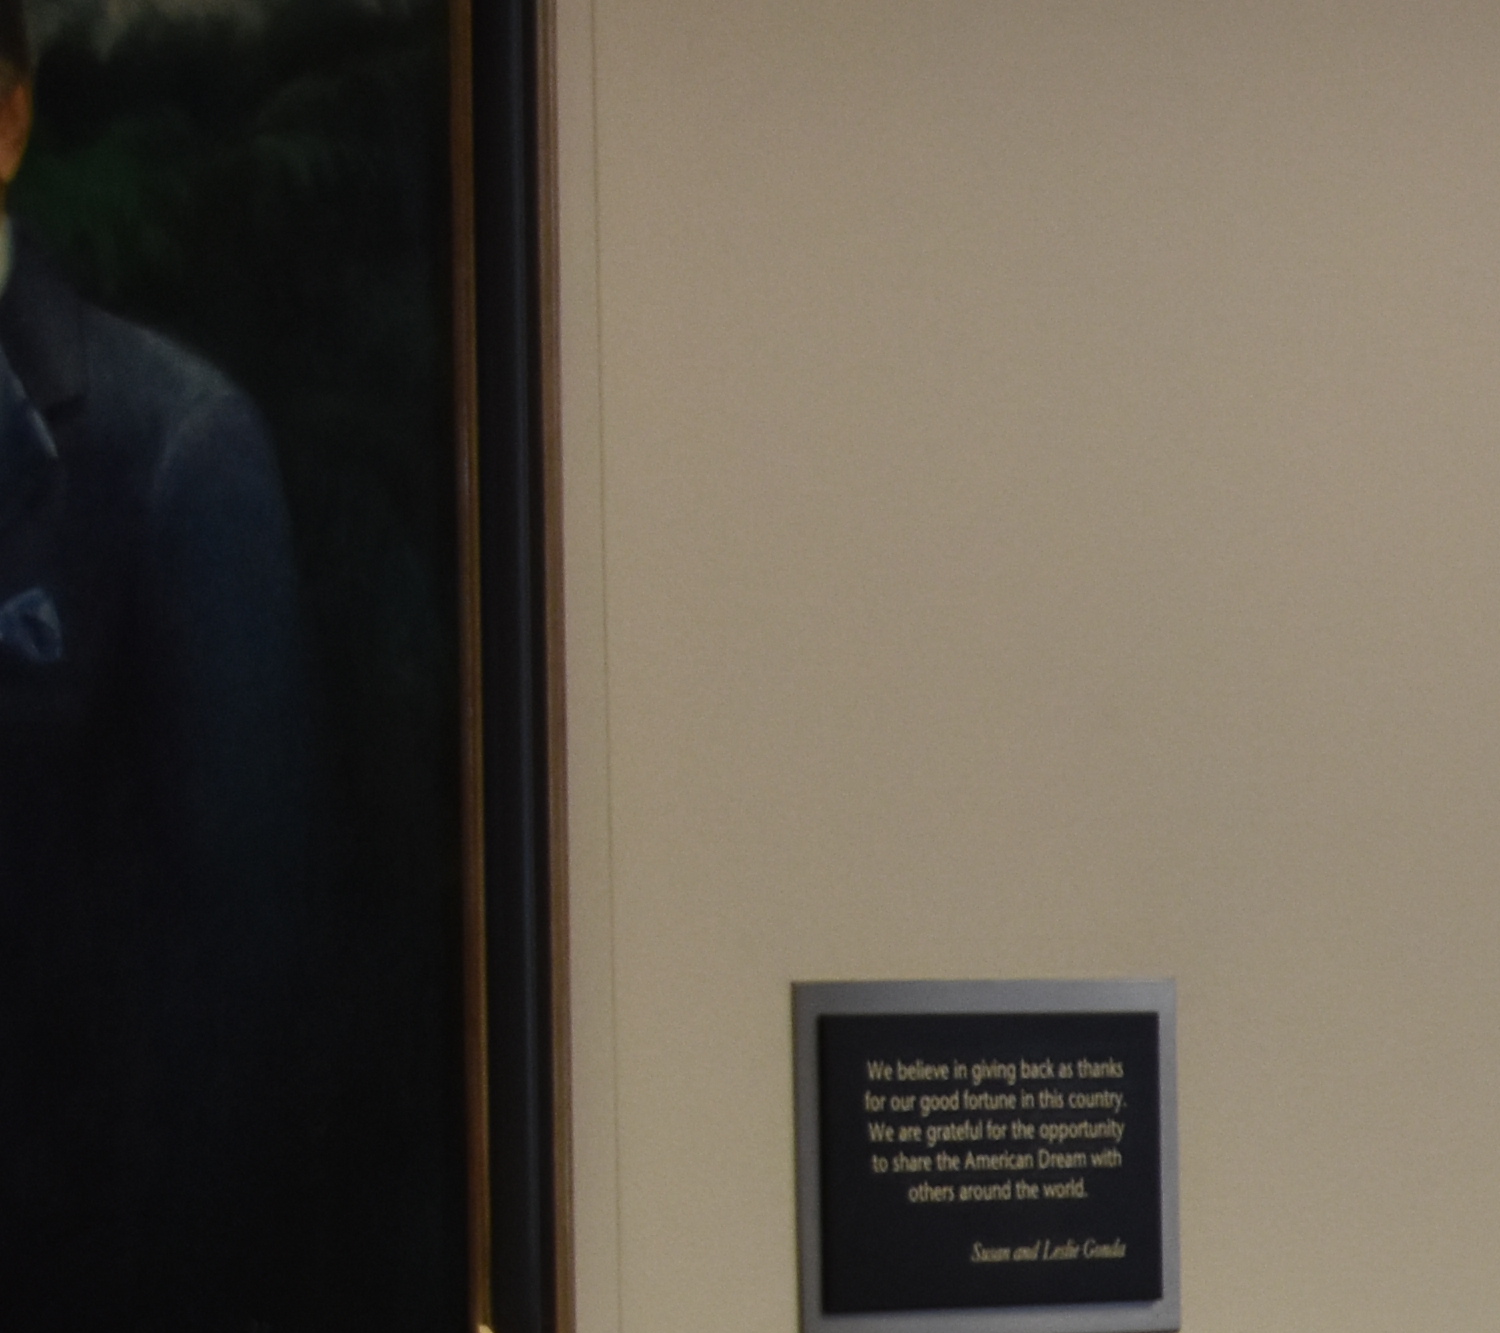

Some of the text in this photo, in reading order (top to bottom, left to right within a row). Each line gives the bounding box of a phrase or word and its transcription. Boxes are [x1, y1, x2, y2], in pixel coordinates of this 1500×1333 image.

[867, 1057, 1124, 1086] We believe in giving back as thanks
[865, 1089, 1127, 1117] for our good fortune in this country.
[868, 1118, 1125, 1147] We are grateful for the opportunity
[872, 1149, 1122, 1173] to share the American Dream with
[908, 1178, 1087, 1203] others around the world.
[1013, 1240, 1039, 1261] and
